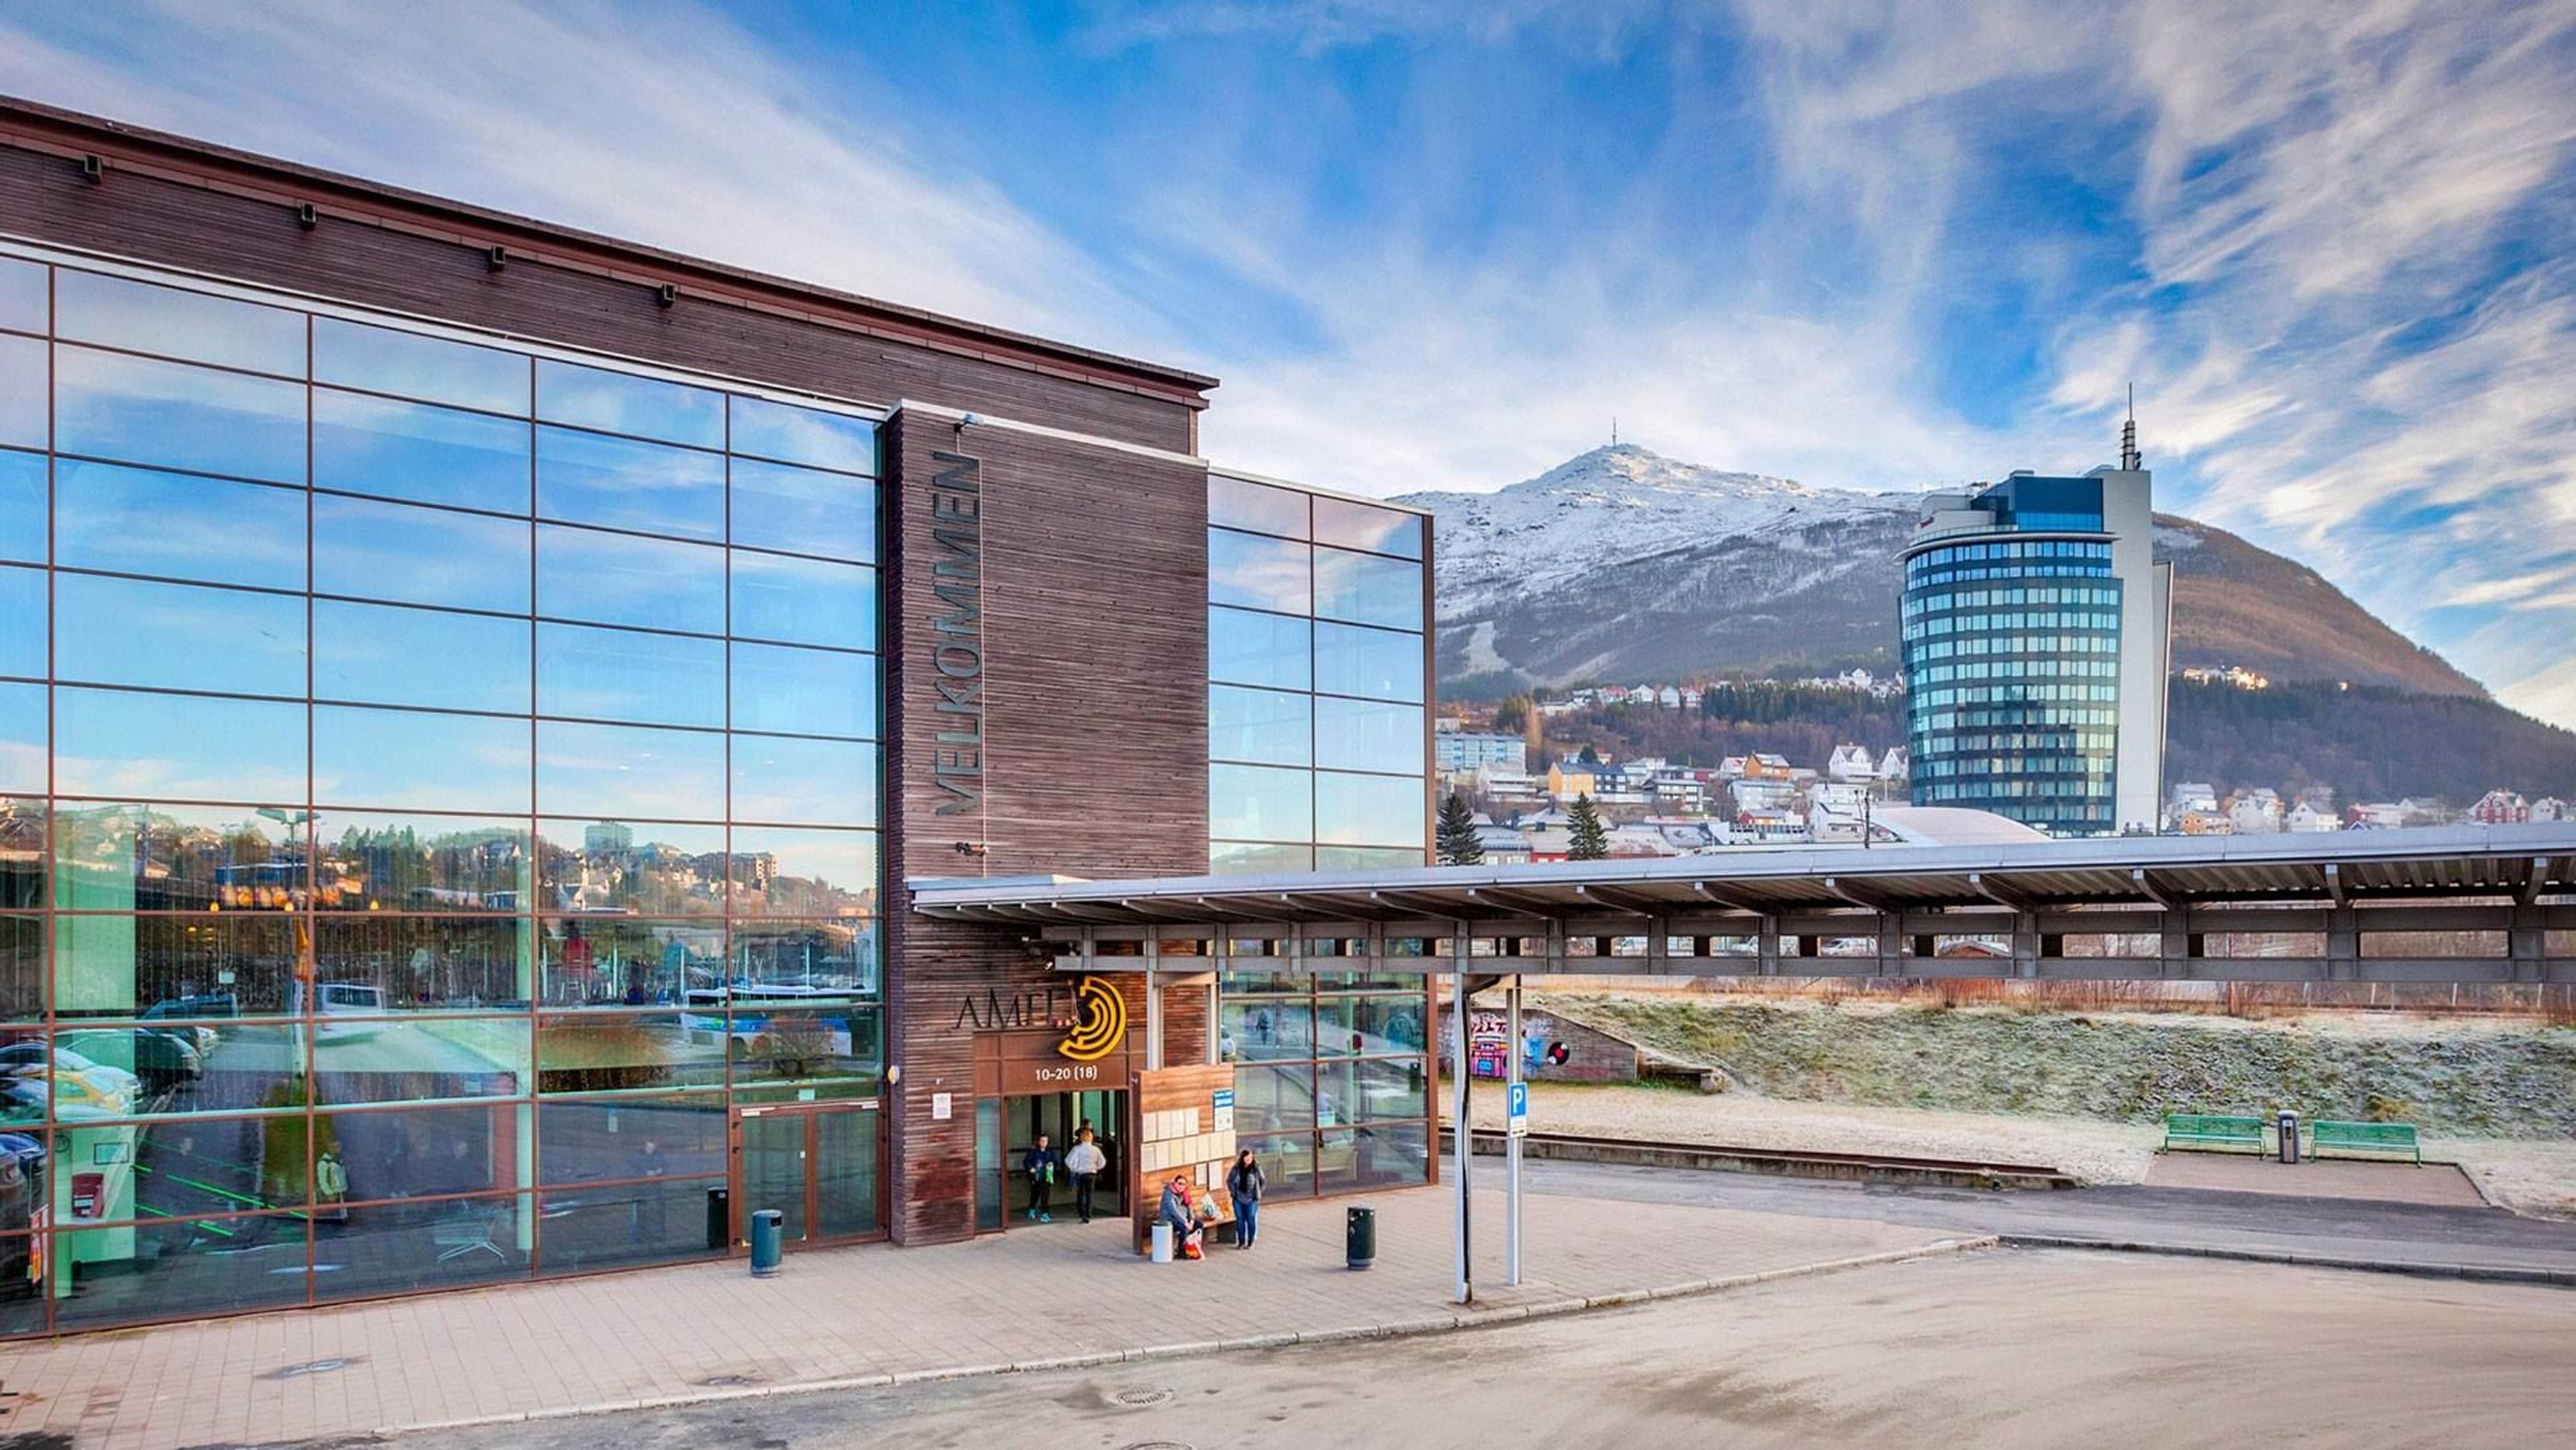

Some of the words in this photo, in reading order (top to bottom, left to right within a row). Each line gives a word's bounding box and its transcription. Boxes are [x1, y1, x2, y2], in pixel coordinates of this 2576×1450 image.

[932, 450, 983, 817] VELKOMMEN
[1035, 1067, 1071, 1082] 10-20
[1074, 1064, 1097, 1081] (18)
[1513, 1088, 1523, 1114] P
